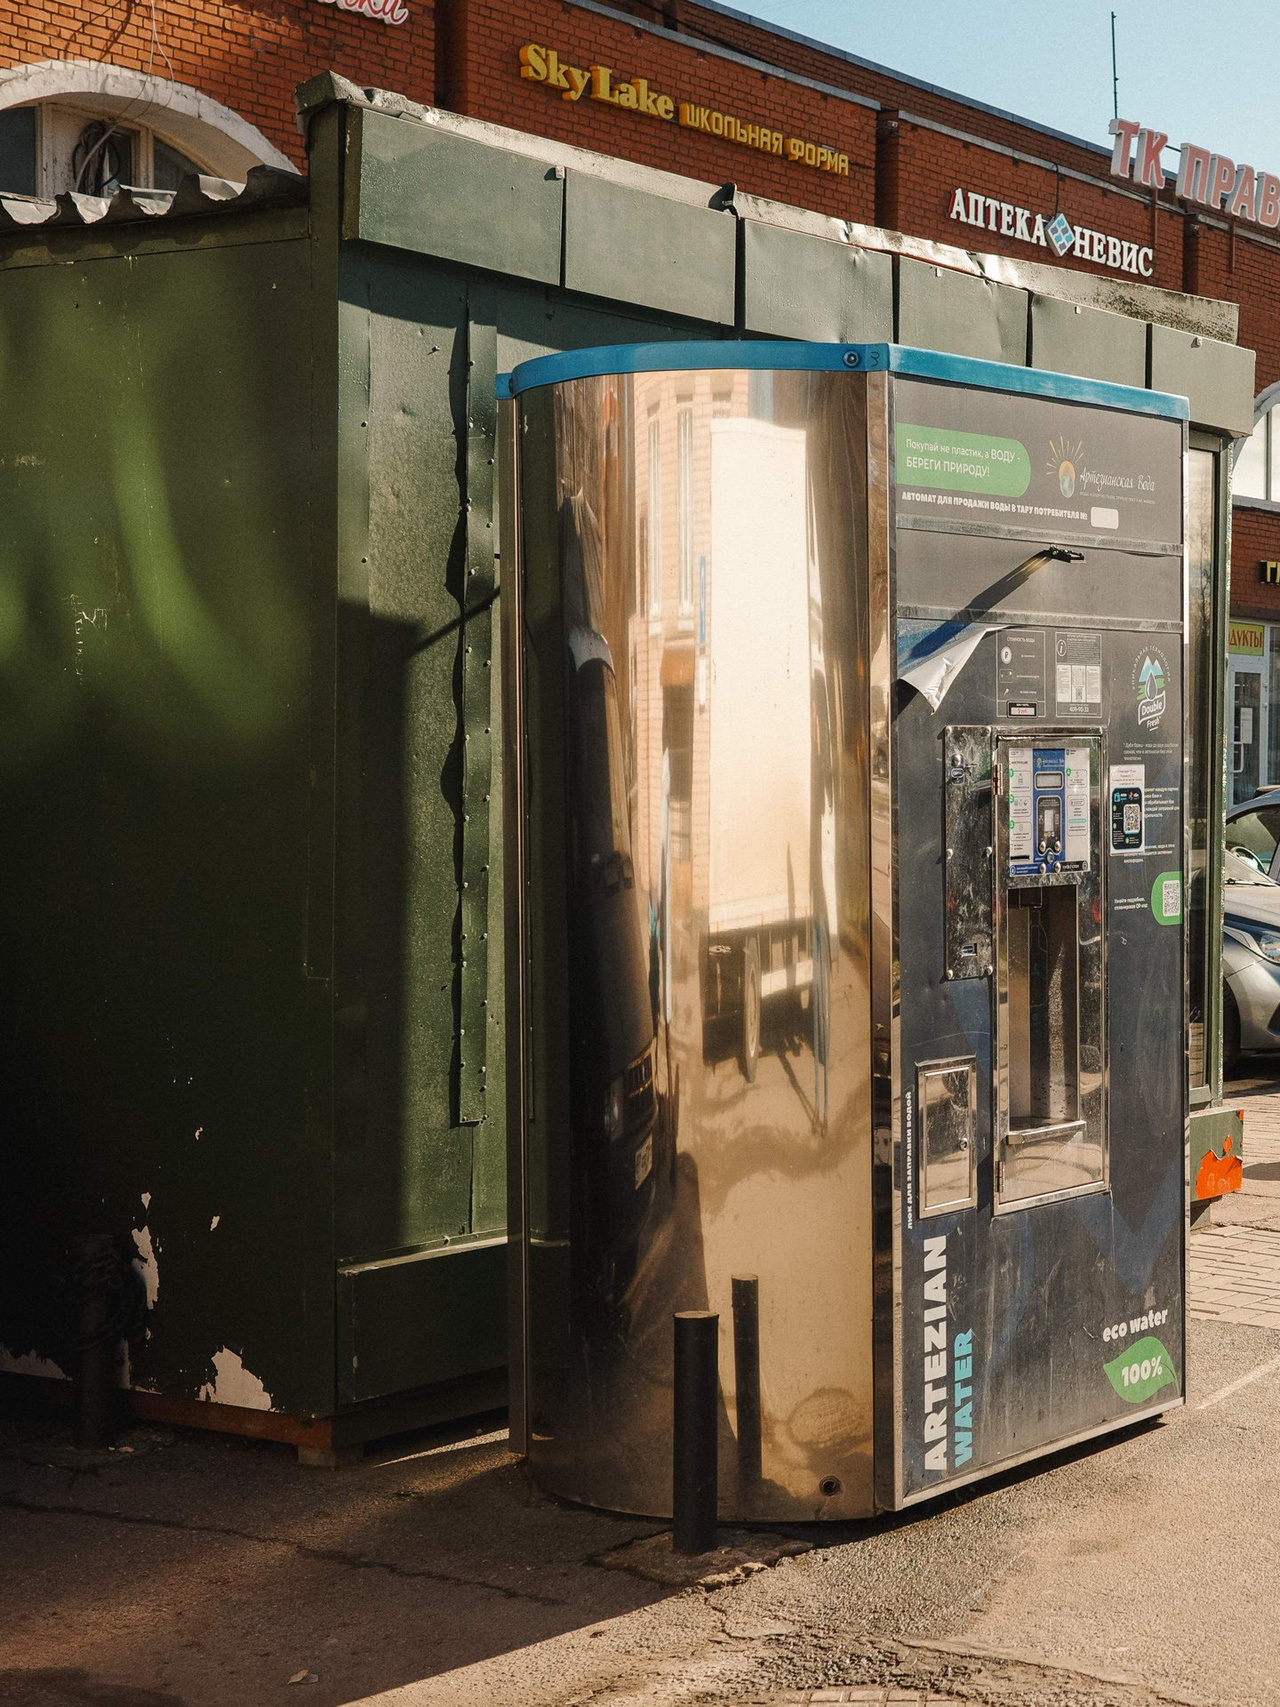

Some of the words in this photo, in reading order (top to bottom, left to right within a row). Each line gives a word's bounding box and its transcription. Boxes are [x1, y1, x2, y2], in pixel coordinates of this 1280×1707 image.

[519, 44, 591, 100] Sky
[590, 65, 674, 120] Lake
[679, 102, 783, 155] ШКОЛЬНАЯ
[785, 138, 848, 176] ФОРМА
[1110, 118, 1169, 189] ТК
[950, 188, 1046, 246] АПТЕКА
[1072, 226, 1153, 277] НЕВИС
[906, 439, 938, 452] Покупай
[940, 445, 949, 454] не
[952, 446, 983, 459] пластик,
[985, 451, 990, 459] а
[991, 448, 1016, 462] ВОДУ
[906, 456, 941, 471] БЕРЕГИ
[943, 461, 990, 477] ПРИРОДУ!
[902, 491, 936, 503] АВТОМАТ
[937, 495, 952, 505] ДЛЯ
[953, 497, 989, 509] ПРОДАЖИ
[990, 502, 1010, 512] ВОДЫ
[1011, 504, 1016, 512] В
[1017, 505, 1033, 514] ТАРУ
[1034, 506, 1079, 519] ПОТРЕБИТЕЛЯ
[1229, 627, 1262, 648] ДУКТЫ
[1141, 701, 1163, 716] Double
[1103, 1327, 1127, 1342] eco
[1129, 1309, 1168, 1334] water
[924, 1235, 947, 1470] ARTEZIAN
[1122, 1356, 1163, 1387] 100%
[954, 1328, 973, 1467] WATER
